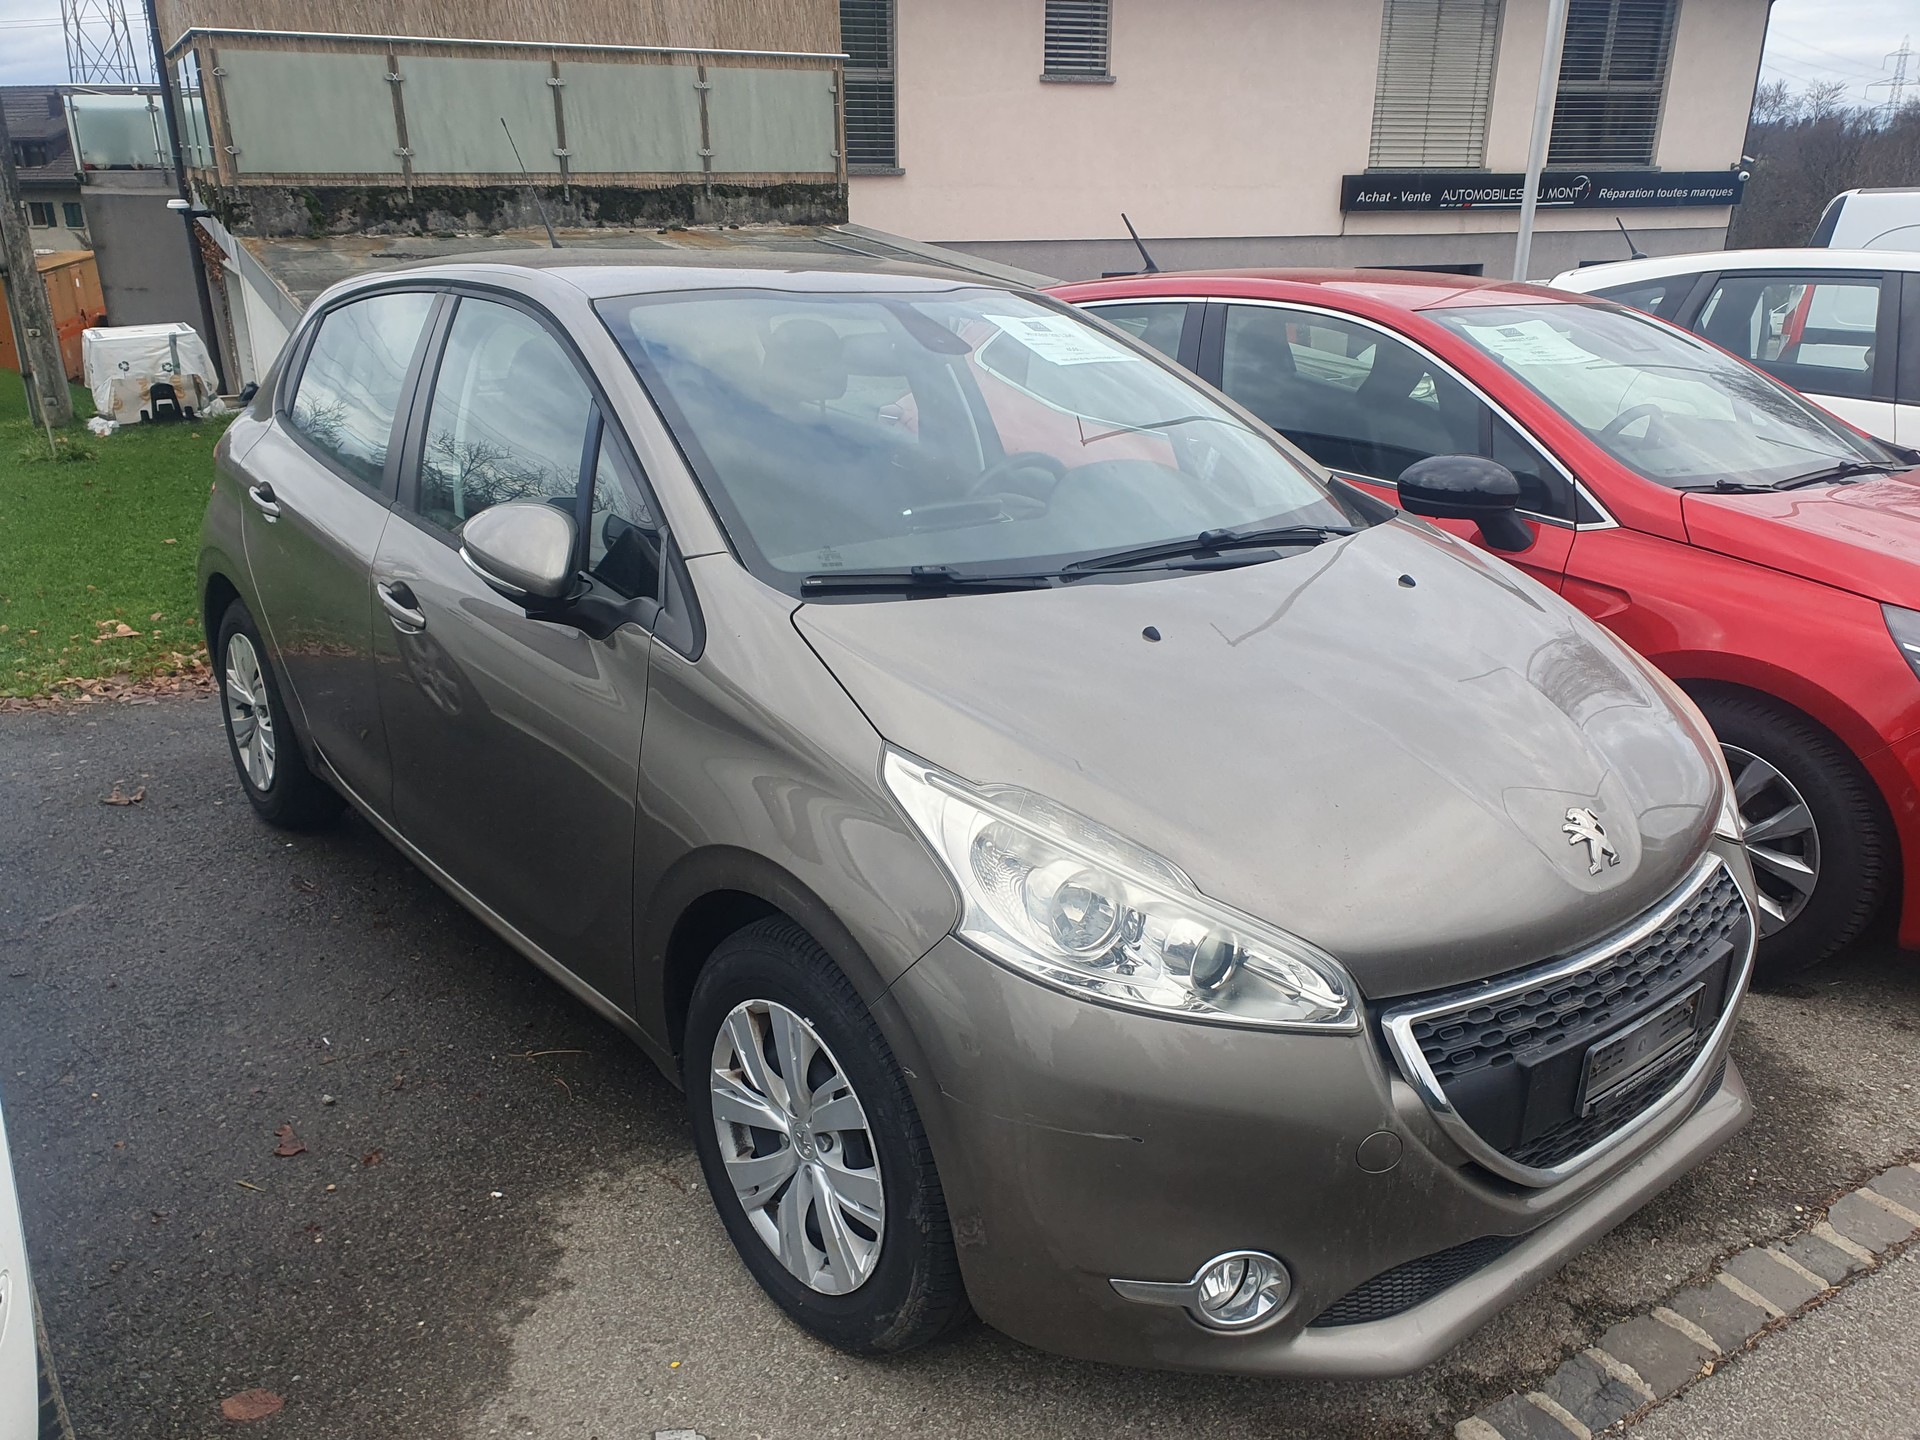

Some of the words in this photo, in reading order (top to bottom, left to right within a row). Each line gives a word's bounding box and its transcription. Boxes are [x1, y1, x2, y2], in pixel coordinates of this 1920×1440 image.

[1356, 191, 1391, 202] Achat
[1401, 191, 1432, 202] Vente
[1440, 188, 1524, 201] AUTOMOBILES
[1547, 187, 1580, 199] MONT
[1598, 188, 1655, 201] Réparation
[1656, 188, 1688, 198] toutes
[1690, 188, 1734, 199] marques
